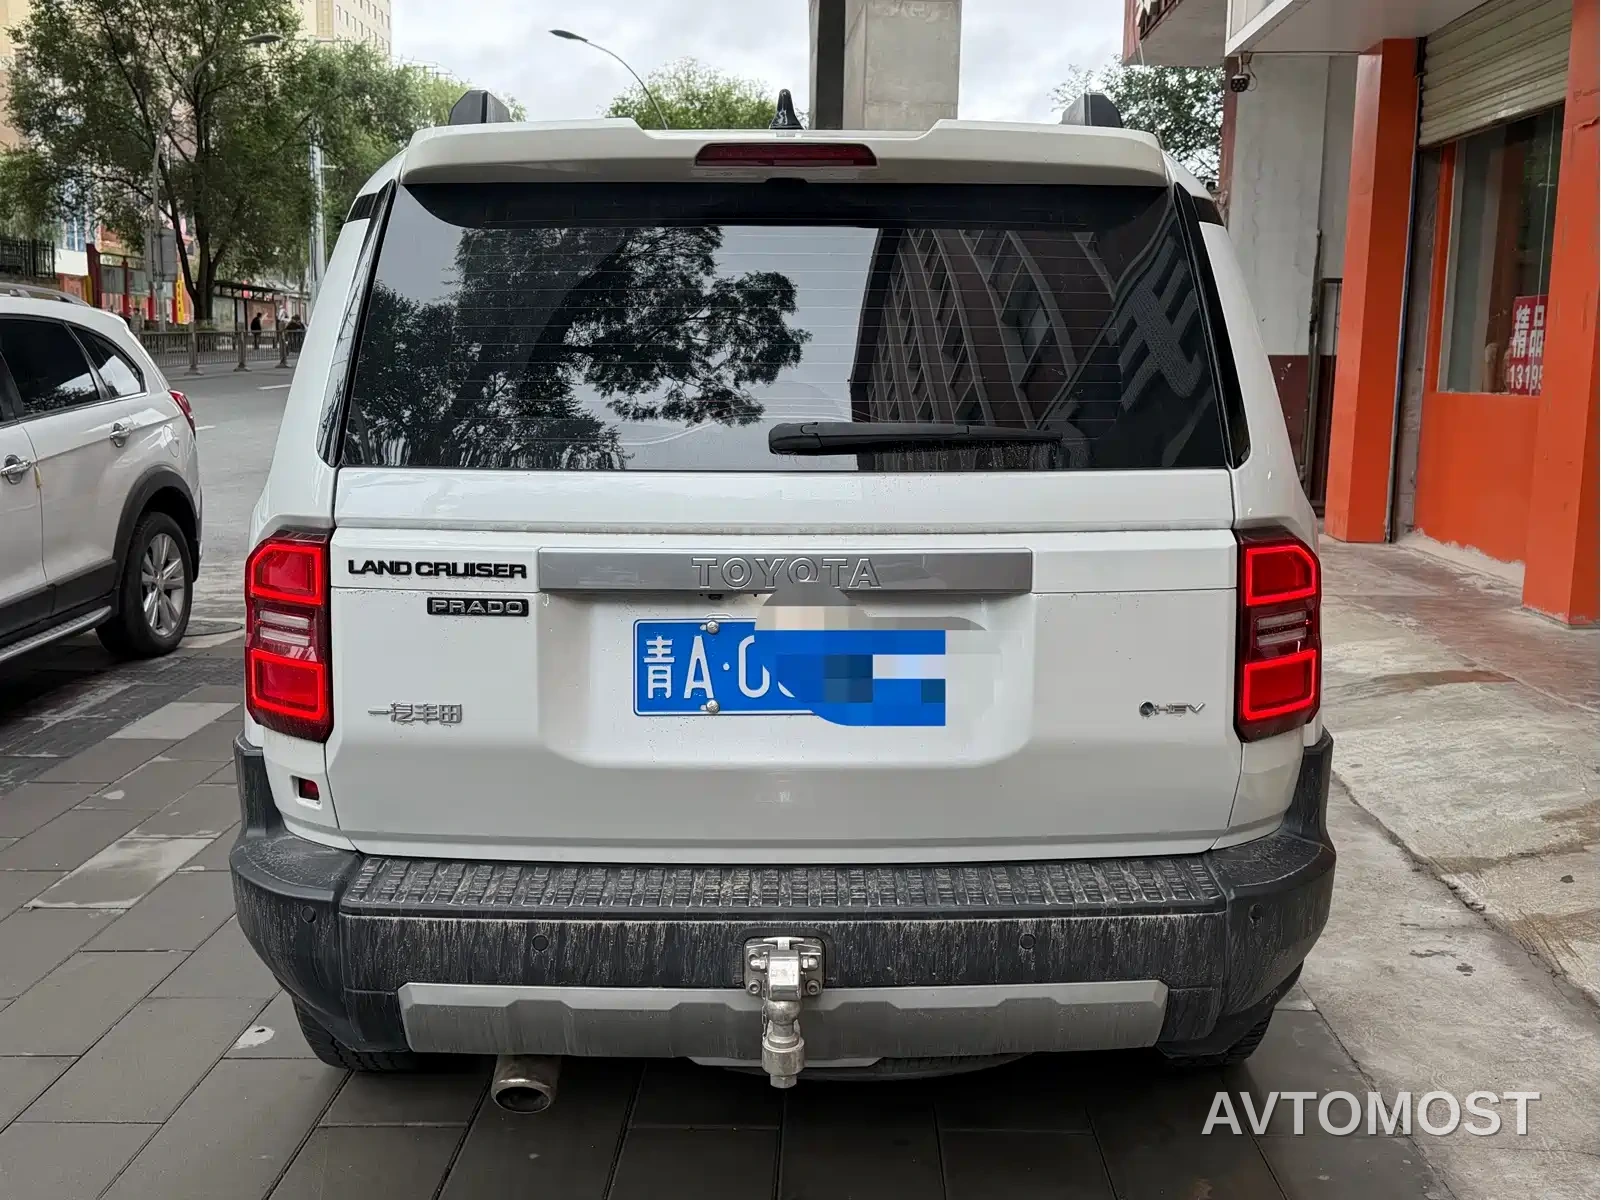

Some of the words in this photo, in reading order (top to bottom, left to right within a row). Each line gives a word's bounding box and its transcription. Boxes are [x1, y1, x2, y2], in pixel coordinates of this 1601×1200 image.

[348, 559, 412, 576] LAND
[415, 561, 528, 579] CRUISER
[691, 557, 882, 589] TOYOTA
[431, 599, 523, 614] PRADO
[367, 702, 463, 724] 一汽丰田
